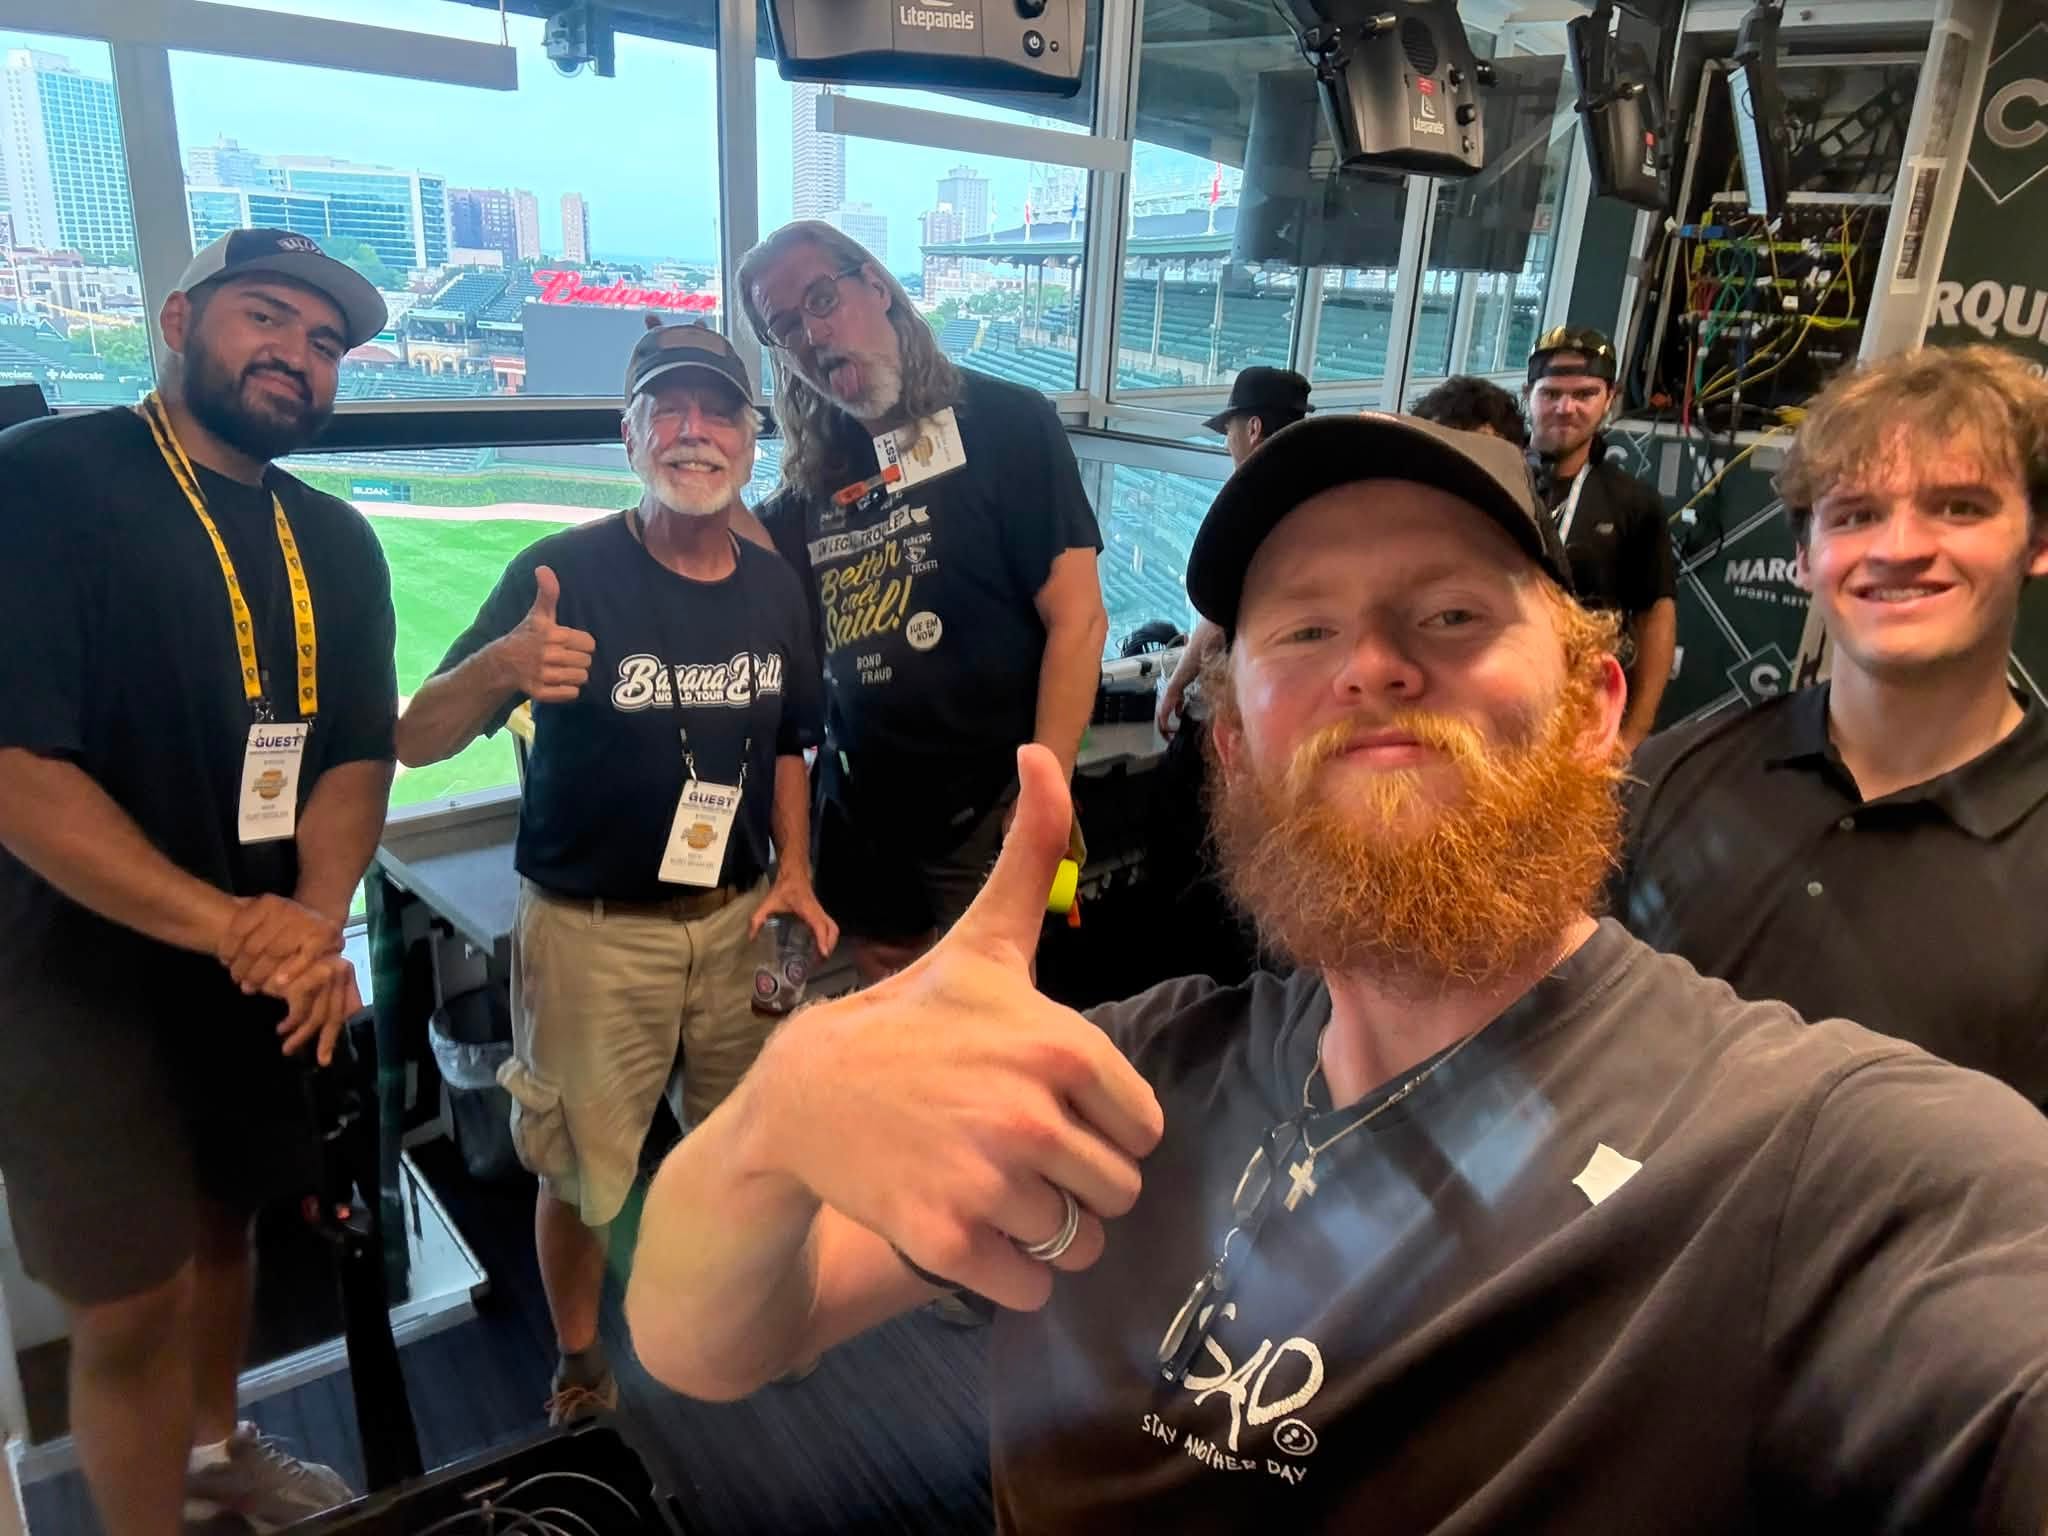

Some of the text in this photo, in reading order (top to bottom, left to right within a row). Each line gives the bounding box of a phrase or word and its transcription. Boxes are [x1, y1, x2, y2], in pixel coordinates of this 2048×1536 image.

[899, 5, 975, 31] Litepanels
[532, 269, 717, 311] Budweiser
[1928, 279, 2048, 345] RQU
[884, 439, 897, 463] EST
[612, 653, 729, 712] Banana
[861, 667, 893, 686] FRAUD
[655, 691, 725, 703] WOLD TOUR
[255, 735, 300, 748] GUEST
[688, 791, 736, 808] GUEST
[1141, 1413, 1177, 1445] STAY
[1266, 1458, 1308, 1485] DAY
